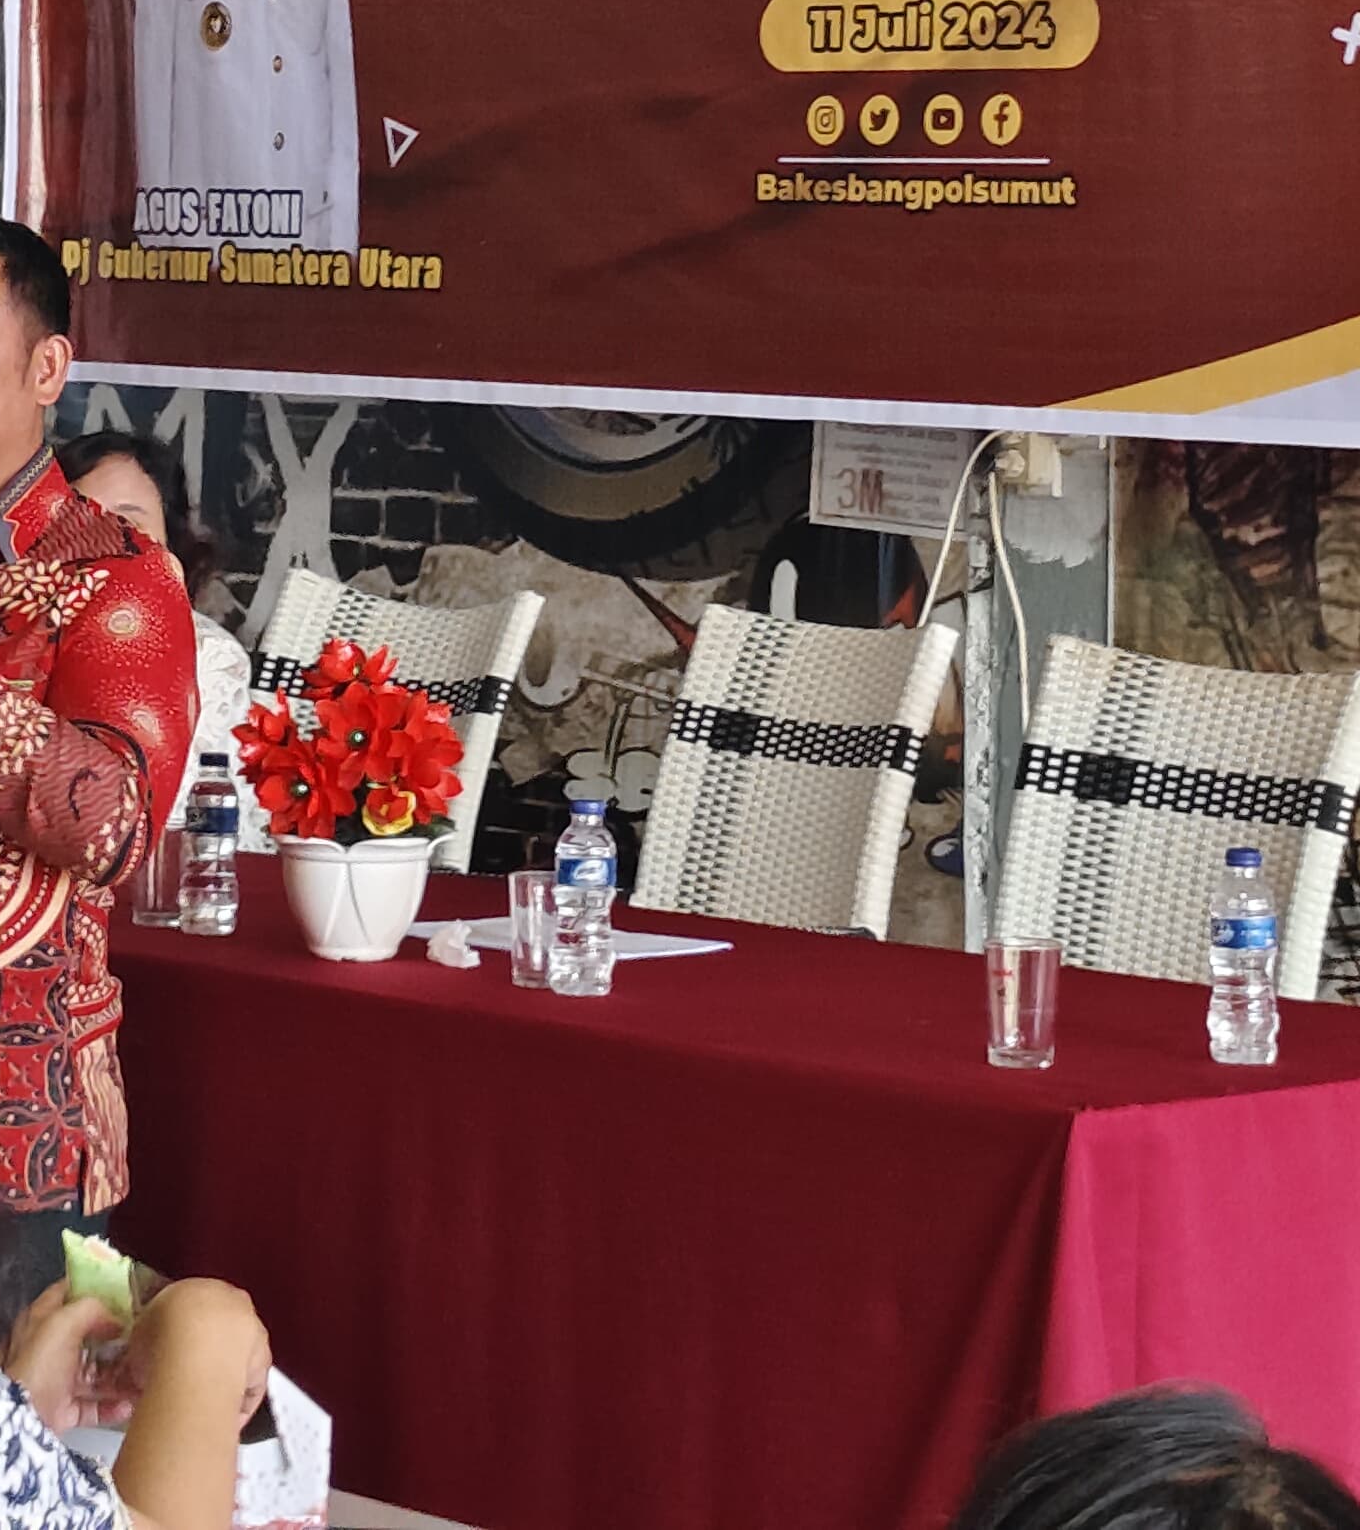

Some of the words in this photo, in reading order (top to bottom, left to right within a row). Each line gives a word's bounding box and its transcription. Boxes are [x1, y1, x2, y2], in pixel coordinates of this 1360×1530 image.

[806, 5, 844, 52] 11
[940, 0, 1056, 51] 2024
[207, 188, 303, 238] FATONI
[755, 172, 1077, 210] Bakesbangpolsumut
[98, 240, 212, 283] Gubernur
[220, 241, 350, 287] Sumatera
[359, 247, 442, 289] Utara
[836, 467, 884, 515] 3M
